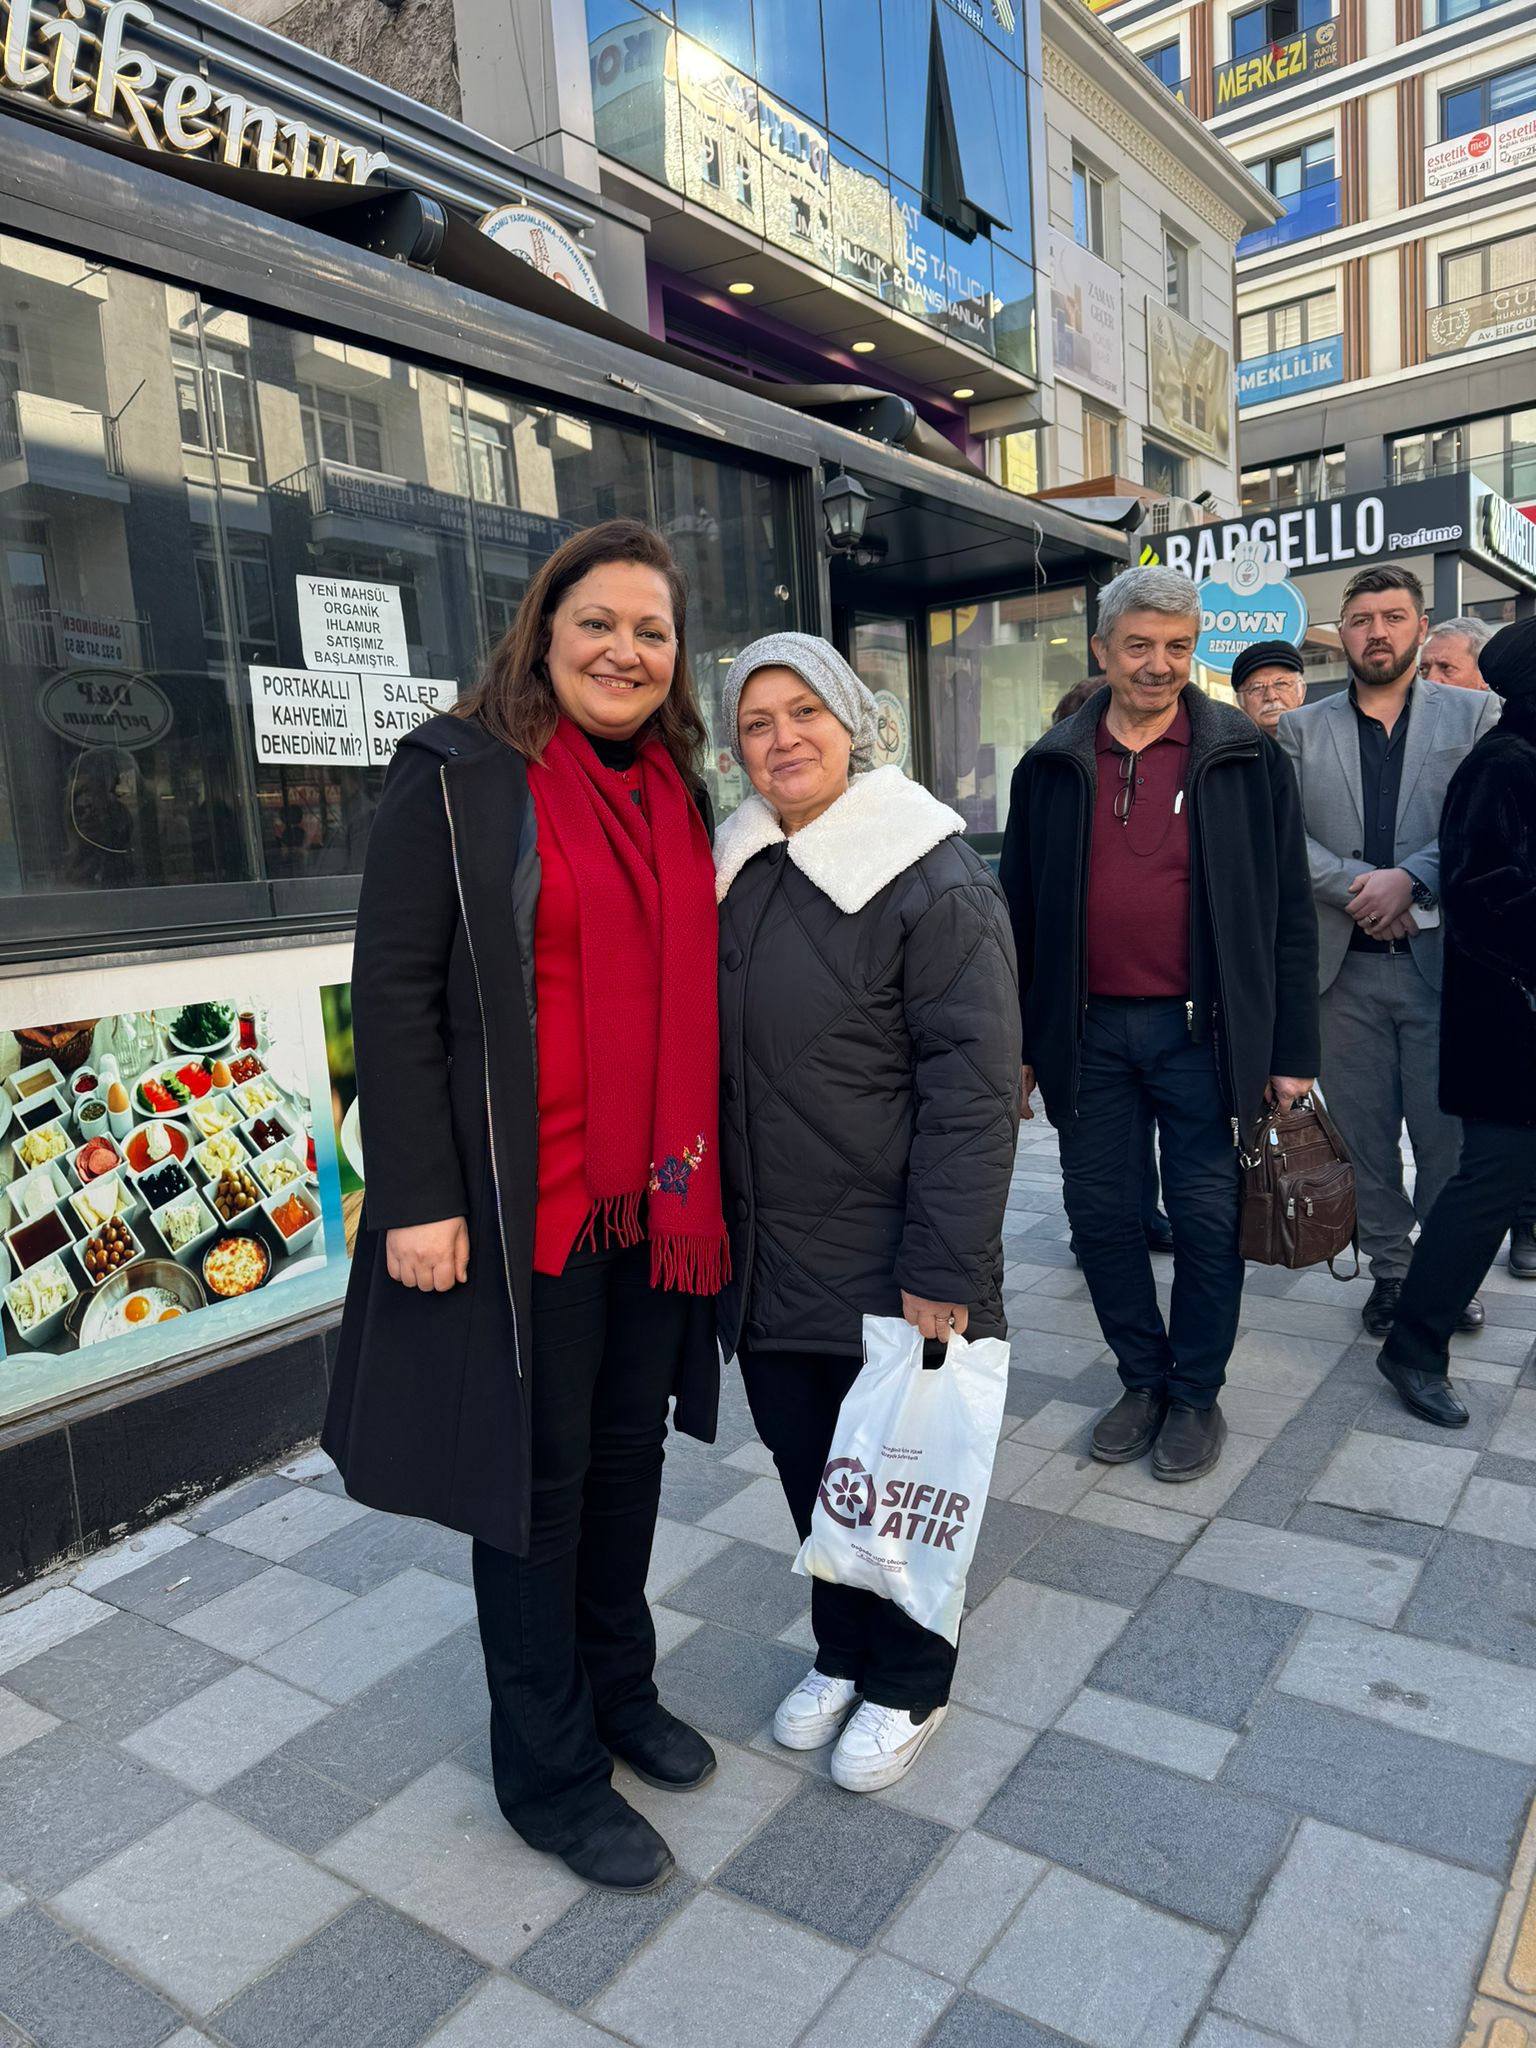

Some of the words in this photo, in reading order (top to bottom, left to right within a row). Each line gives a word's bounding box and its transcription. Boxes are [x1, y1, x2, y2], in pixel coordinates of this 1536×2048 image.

[1218, 33, 1308, 104] MERKEZİ
[1427, 145, 1467, 168] estetik
[1470, 136, 1490, 152] med
[1453, 169, 1467, 180] 214
[1468, 165, 1479, 174] 41
[1480, 161, 1490, 170] 41
[1494, 286, 1536, 311] GÜ
[1496, 306, 1529, 321] HUKUK
[1477, 332, 1494, 342] Av.
[1496, 324, 1515, 336] Elif
[1236, 350, 1333, 392] MEKLİLİK
[1389, 525, 1463, 552] Perfume
[1499, 498, 1536, 575] BARGELL
[309, 583, 338, 598] YENİ
[341, 586, 390, 603] MAHSÜL
[324, 601, 380, 618] ORGANİK
[1202, 609, 1288, 634] DOWN
[326, 619, 381, 634] IHLAMUR
[326, 635, 384, 651] SATIŞIMIZ
[314, 651, 399, 668] BAŞLAMIŞTIR.
[263, 675, 350, 700] PORTAKALLI
[384, 683, 439, 705] SALEP
[272, 703, 348, 728] KAHVEMİZİ
[261, 731, 337, 756] DENEDİNİZ
[340, 733, 362, 756] Mİ?
[881, 1480, 971, 1522] SIFIR
[878, 1511, 964, 1551] ATIK
